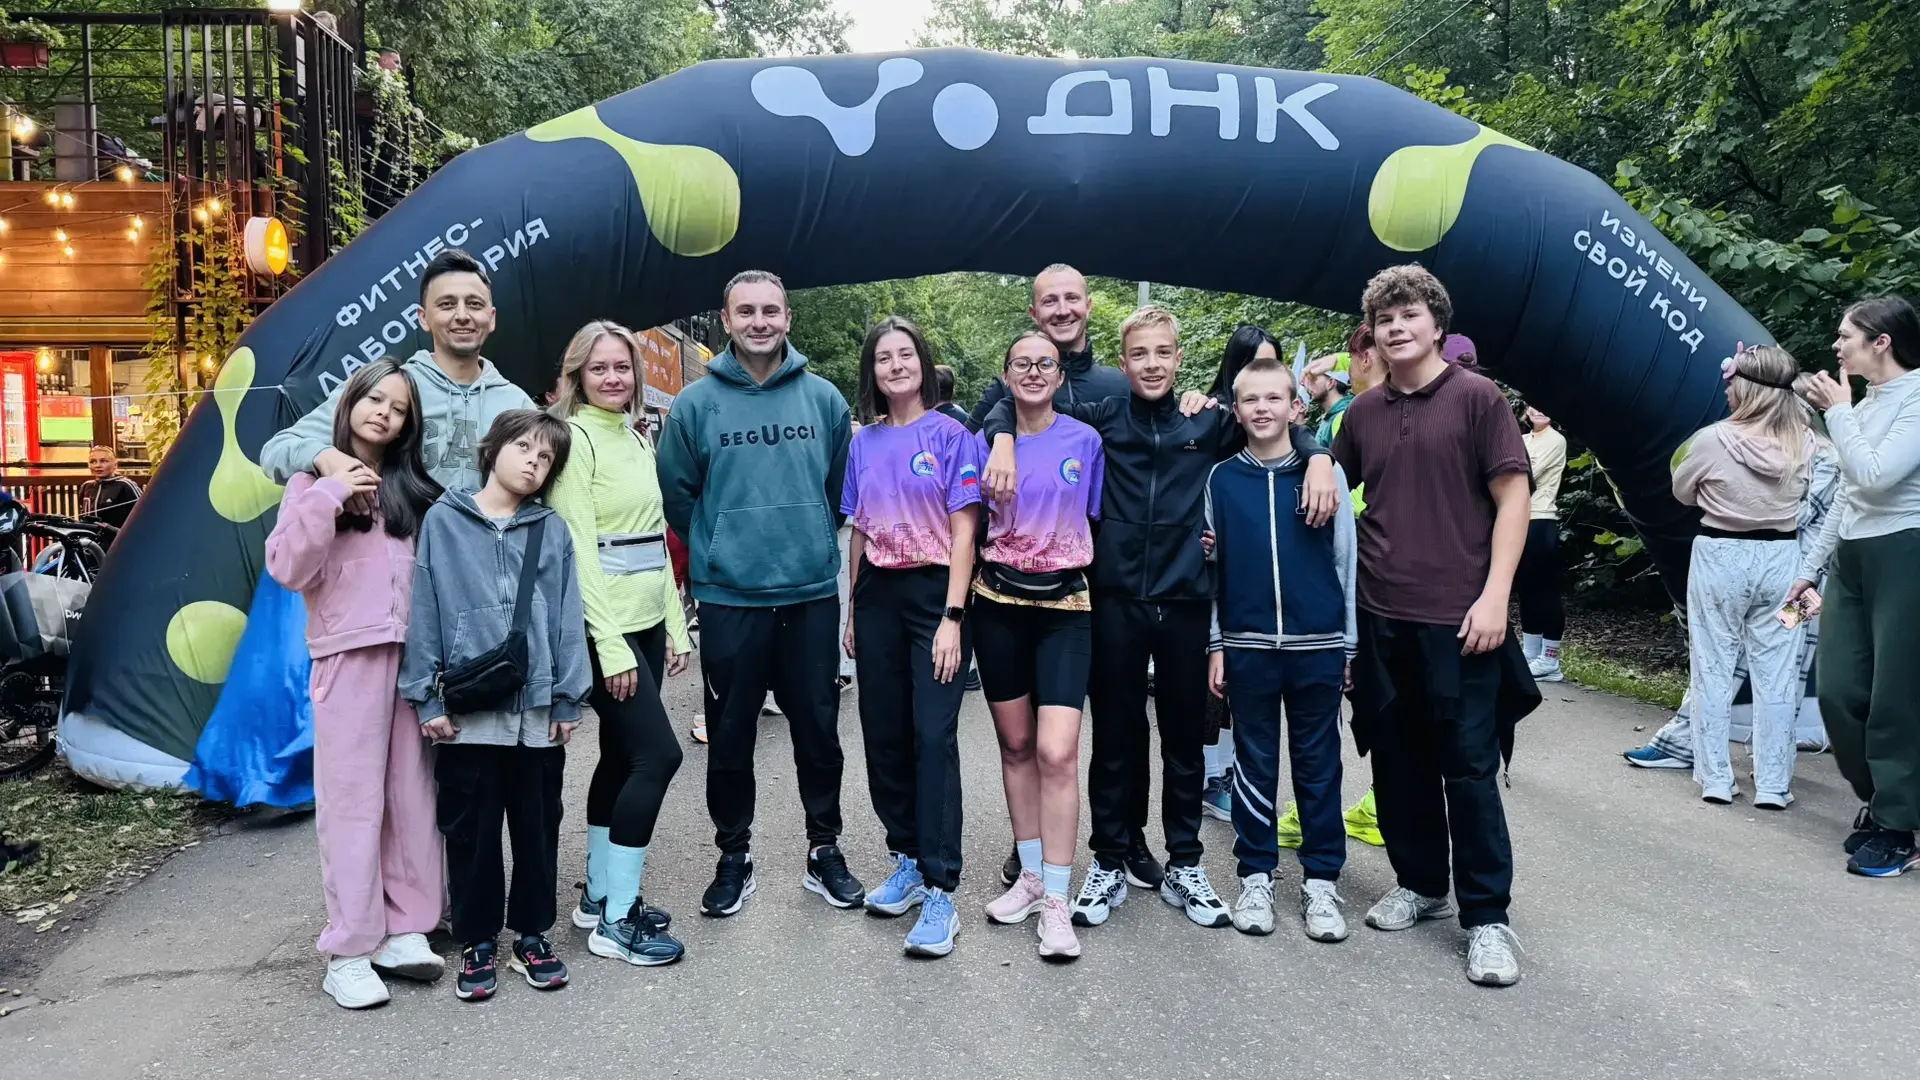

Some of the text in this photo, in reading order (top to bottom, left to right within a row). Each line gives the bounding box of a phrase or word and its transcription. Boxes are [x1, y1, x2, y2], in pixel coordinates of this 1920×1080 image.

[1027, 66, 1340, 151] ДНК
[1573, 229, 1705, 354] СВОЙ КОД
[1600, 209, 1708, 312] ИЗМЕНИ
